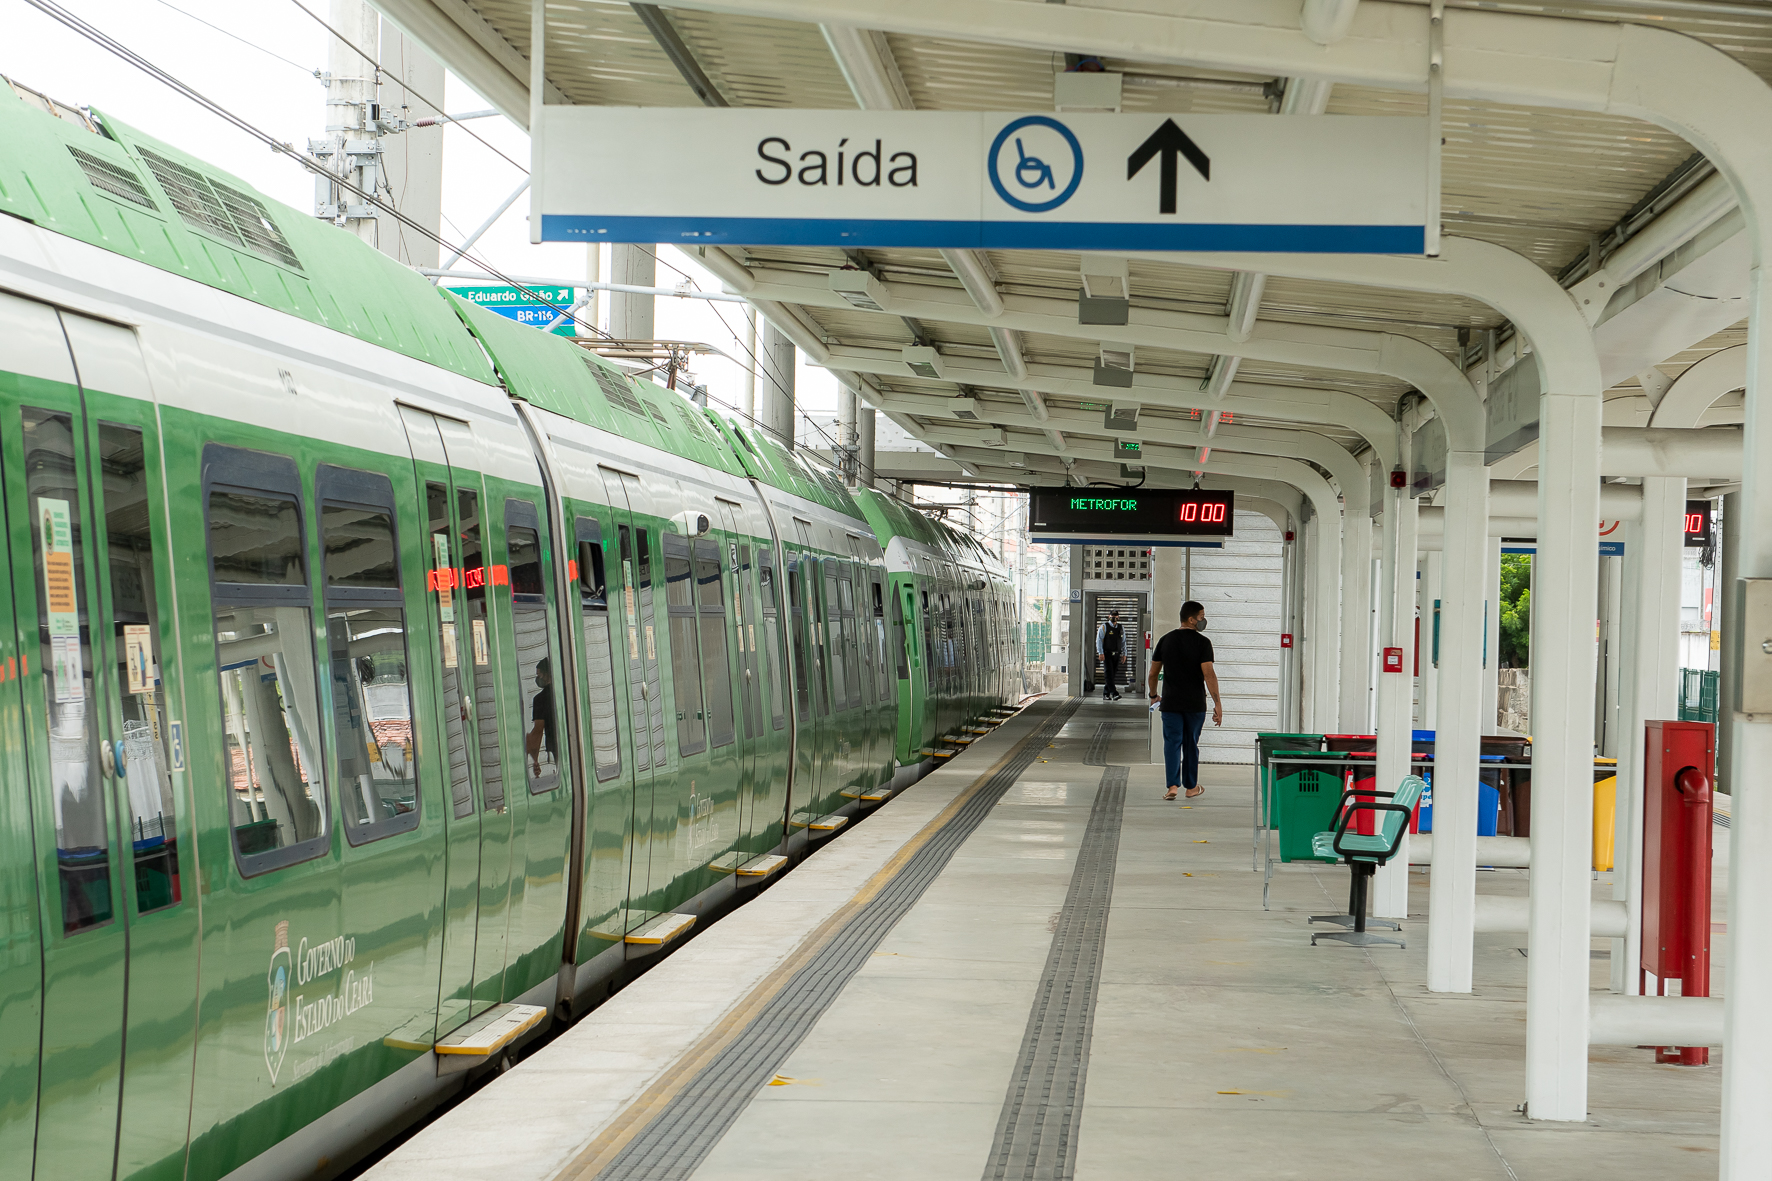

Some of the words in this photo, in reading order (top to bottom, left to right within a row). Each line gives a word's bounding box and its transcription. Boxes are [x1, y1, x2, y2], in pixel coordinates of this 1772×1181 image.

[755, 136, 919, 188] Saída
[468, 291, 516, 302] Eduardo
[517, 310, 554, 322] BR-116
[1071, 498, 1137, 511] METROFOR
[1179, 502, 1198, 522] 10
[1200, 502, 1226, 523] 00
